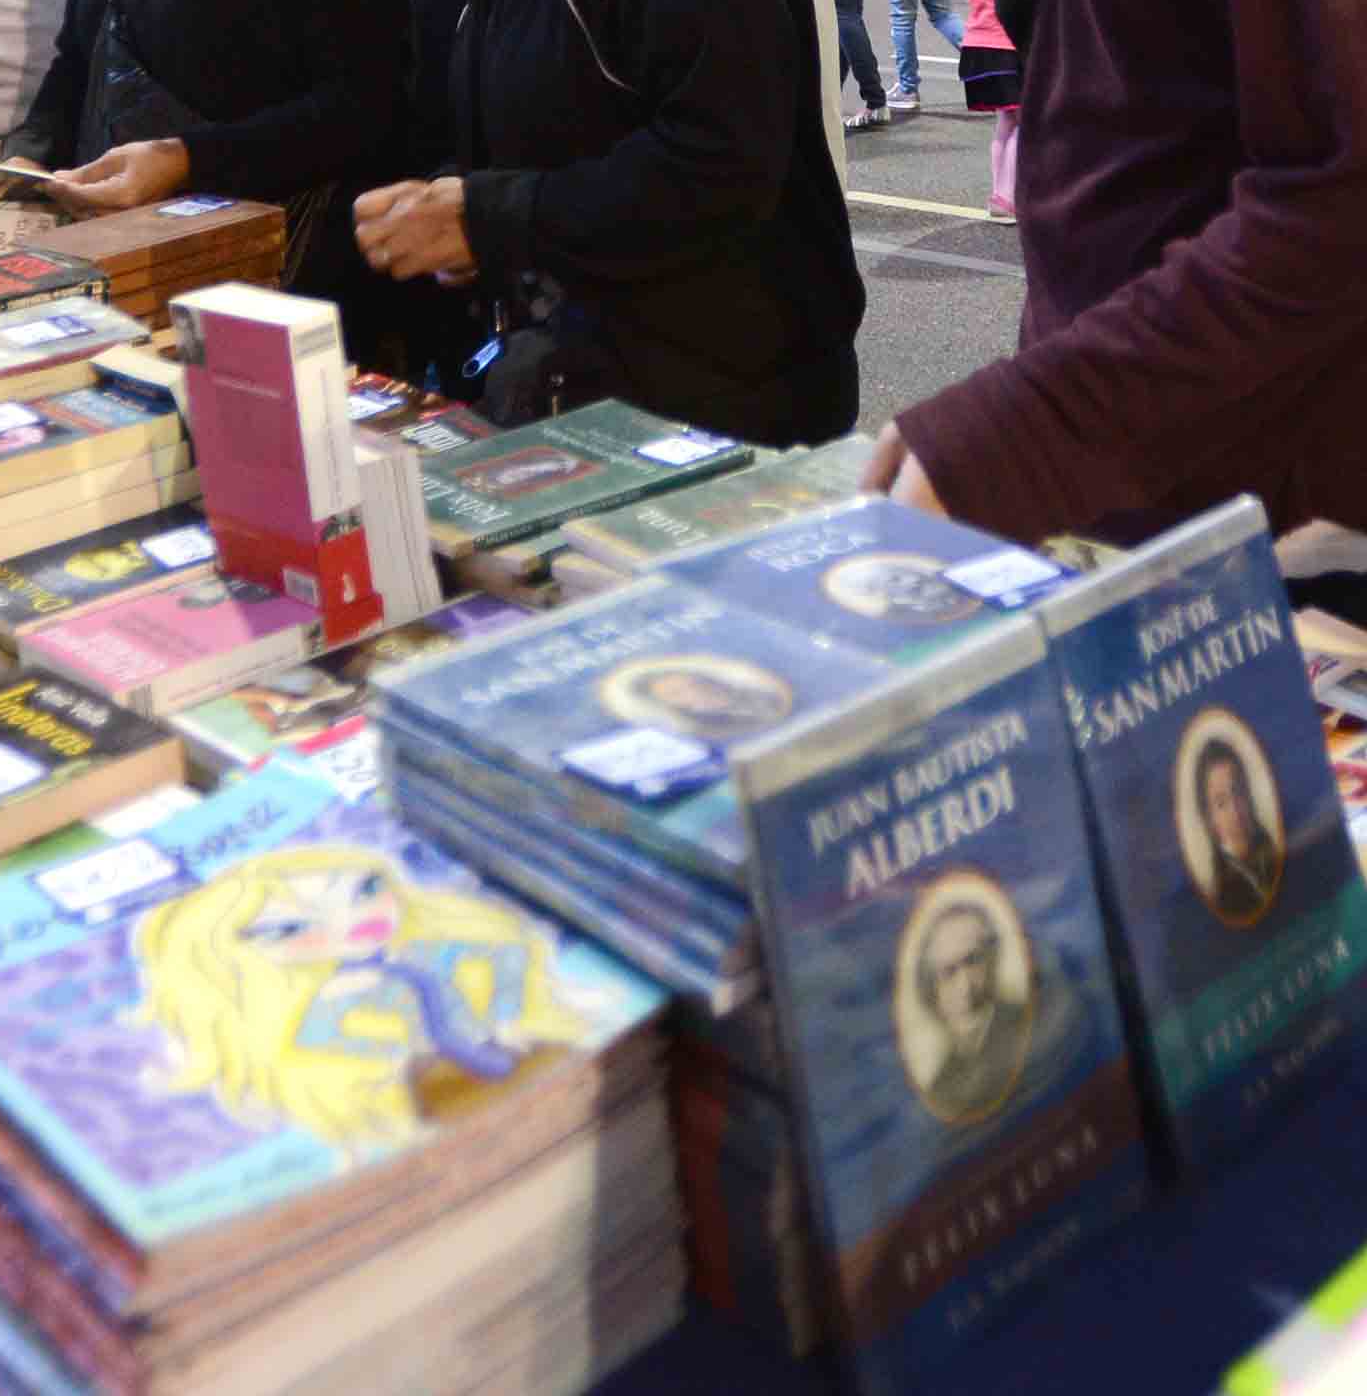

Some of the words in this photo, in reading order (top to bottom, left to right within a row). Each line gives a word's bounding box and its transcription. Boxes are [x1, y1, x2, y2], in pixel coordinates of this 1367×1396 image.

[1160, 604, 1282, 708] MARTÍN
[807, 785, 889, 858] JUAN
[893, 710, 1029, 805] BAUTISTA
[847, 764, 1014, 900] ALBERDI
